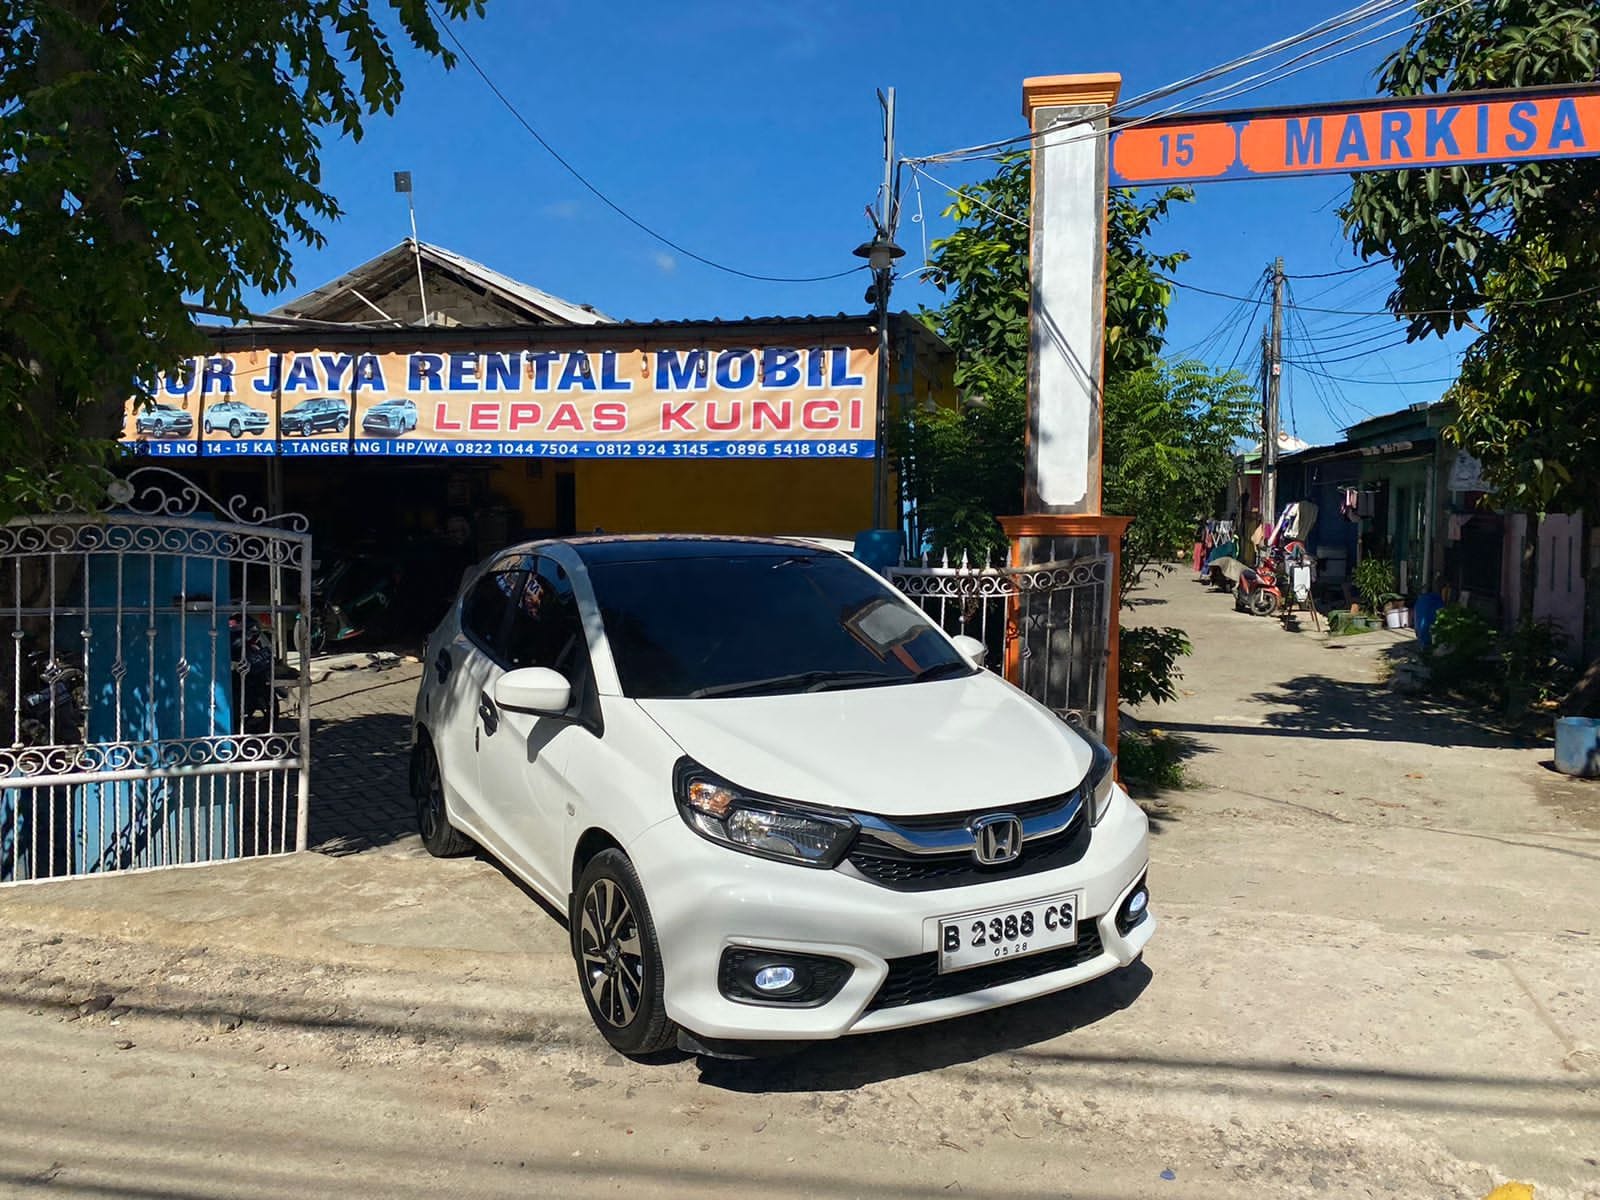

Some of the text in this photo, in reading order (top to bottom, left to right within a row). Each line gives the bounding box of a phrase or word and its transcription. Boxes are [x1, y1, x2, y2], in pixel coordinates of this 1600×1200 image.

[1158, 98, 1586, 168] 15 MARKISA
[134, 347, 864, 396] UR JAYA RENTAL MOBIL
[434, 400, 861, 431] LEPAS KUNCI
[157, 442, 172, 455] 15
[207, 443, 222, 454] 14
[236, 442, 249, 454] 15
[292, 441, 381, 454] TANGERANG
[396, 441, 450, 455] HP/WA
[455, 442, 493, 455] 0822
[497, 442, 534, 455] 1044
[540, 443, 579, 455] 7504
[596, 443, 632, 455] 0812
[637, 443, 667, 455] 924
[672, 443, 709, 455] 3145
[726, 443, 767, 455] 0896
[774, 443, 811, 455] 5418
[816, 442, 859, 455] 0845
[943, 902, 1074, 953] B 2388 CS
[993, 942, 1028, 958] 05 28
